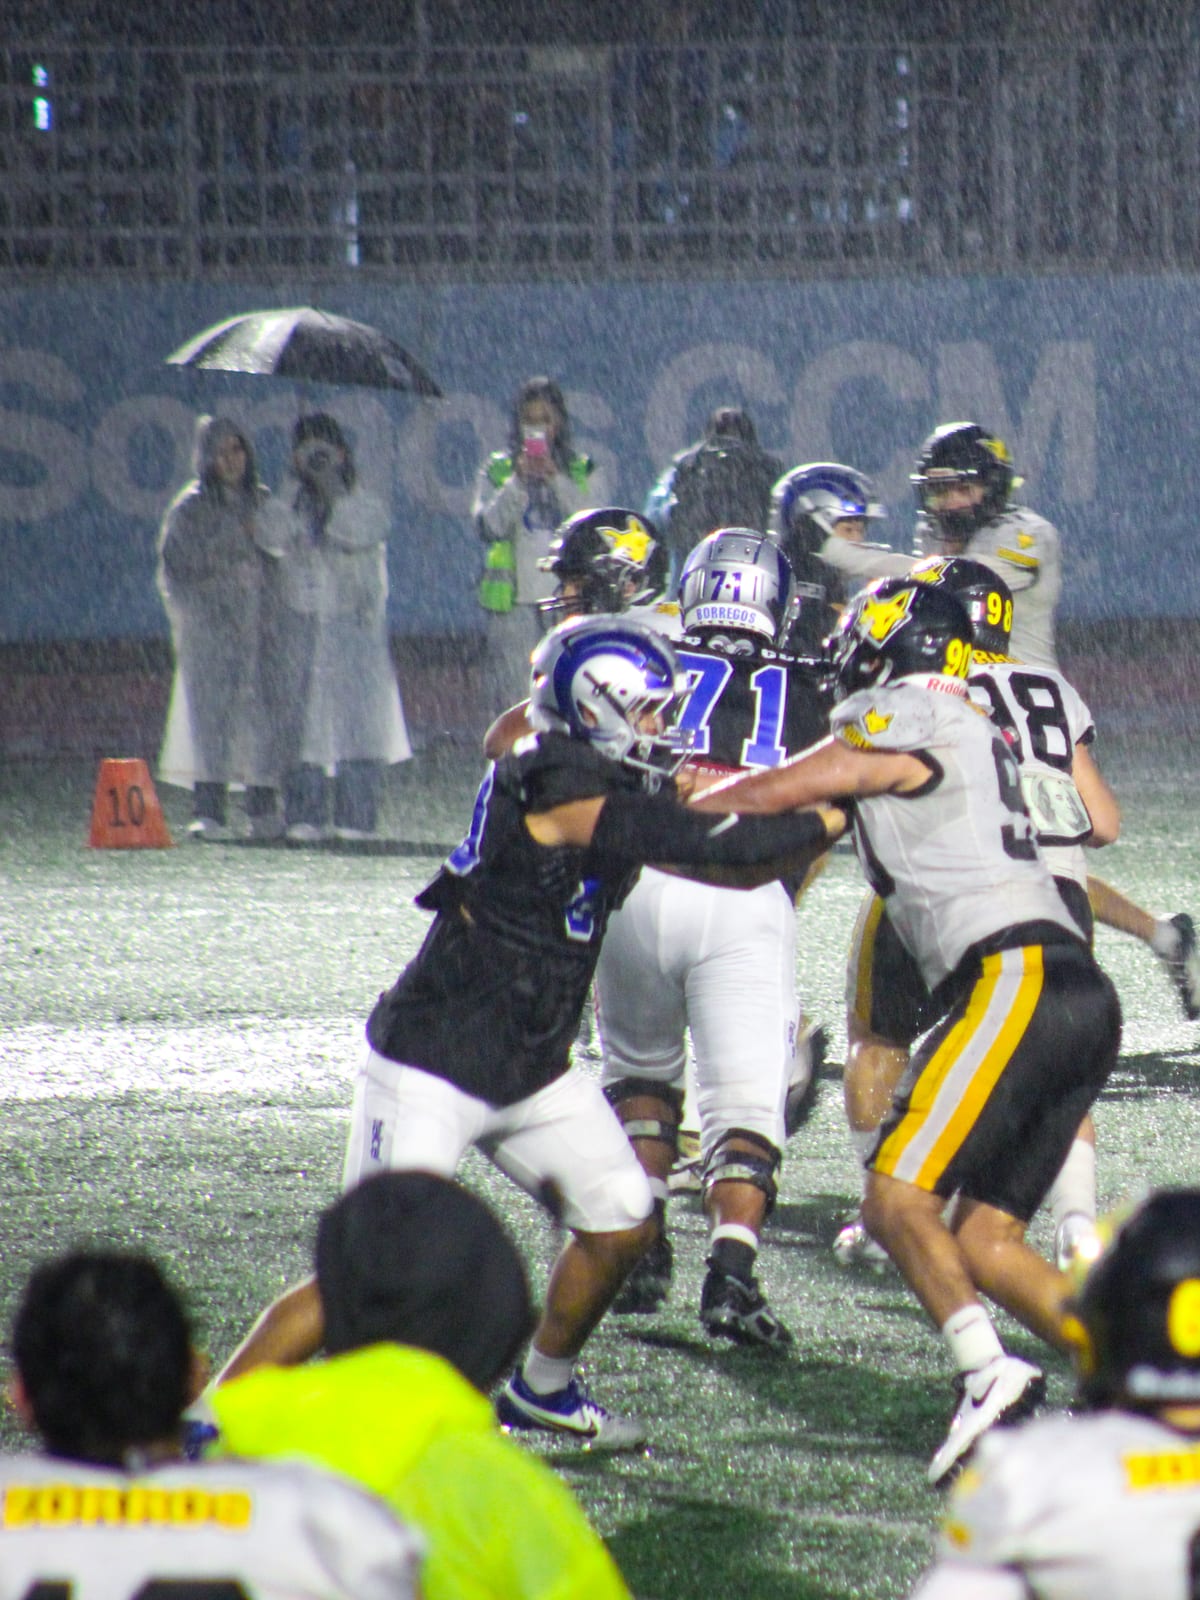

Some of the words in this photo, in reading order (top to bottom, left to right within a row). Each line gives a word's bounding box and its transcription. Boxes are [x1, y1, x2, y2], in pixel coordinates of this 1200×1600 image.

[711, 570, 742, 602] 71
[696, 606, 757, 624] BORREGOS
[986, 592, 1013, 632] 98
[664, 650, 789, 769] 71
[109, 785, 145, 827] 10
